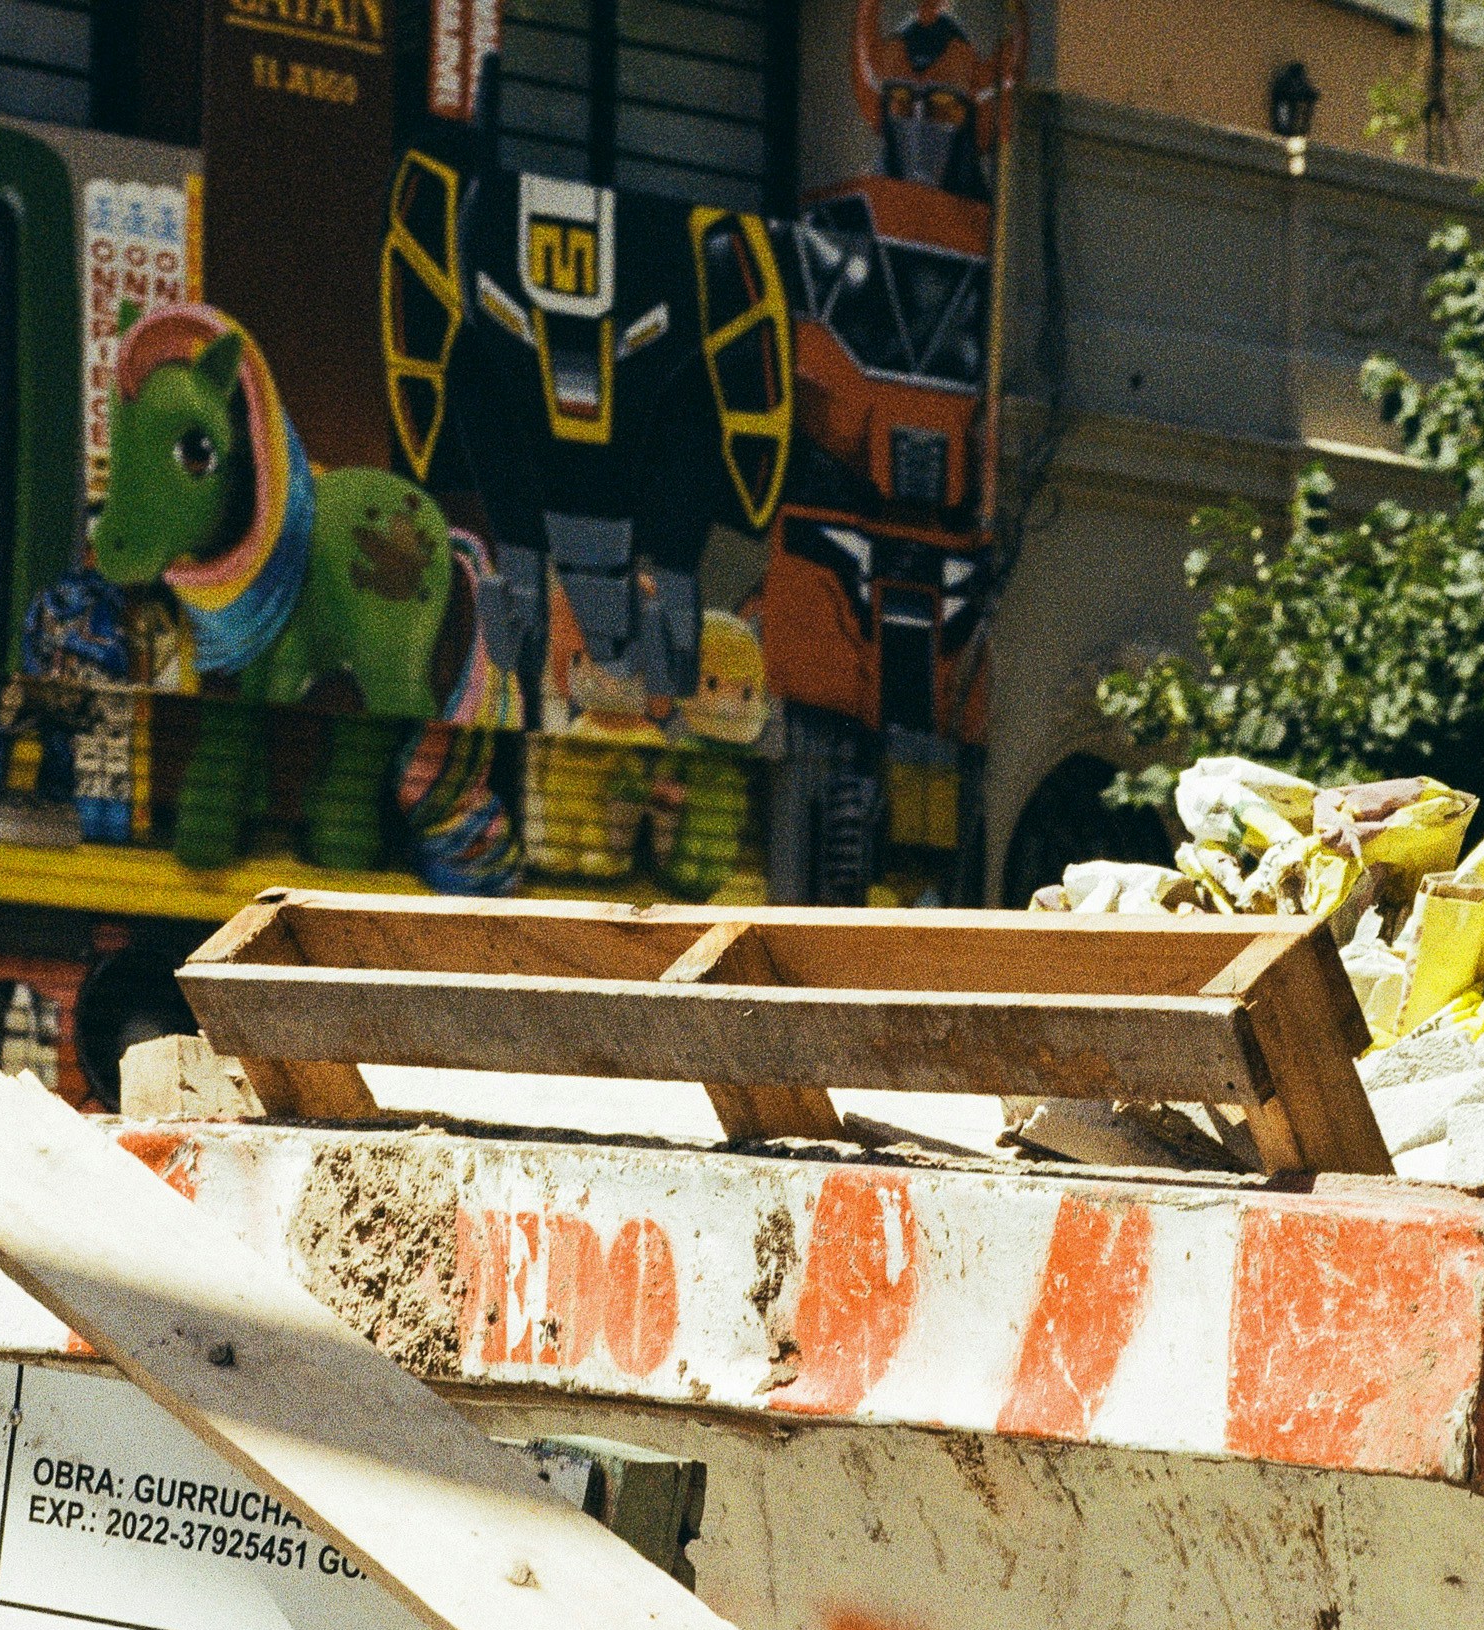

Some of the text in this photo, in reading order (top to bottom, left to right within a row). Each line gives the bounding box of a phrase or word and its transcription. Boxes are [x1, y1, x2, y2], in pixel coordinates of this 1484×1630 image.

[33, 1457, 123, 1499] OBRA:
[28, 1495, 95, 1533] EXP.:
[104, 1508, 308, 1570] 2022-37925451
